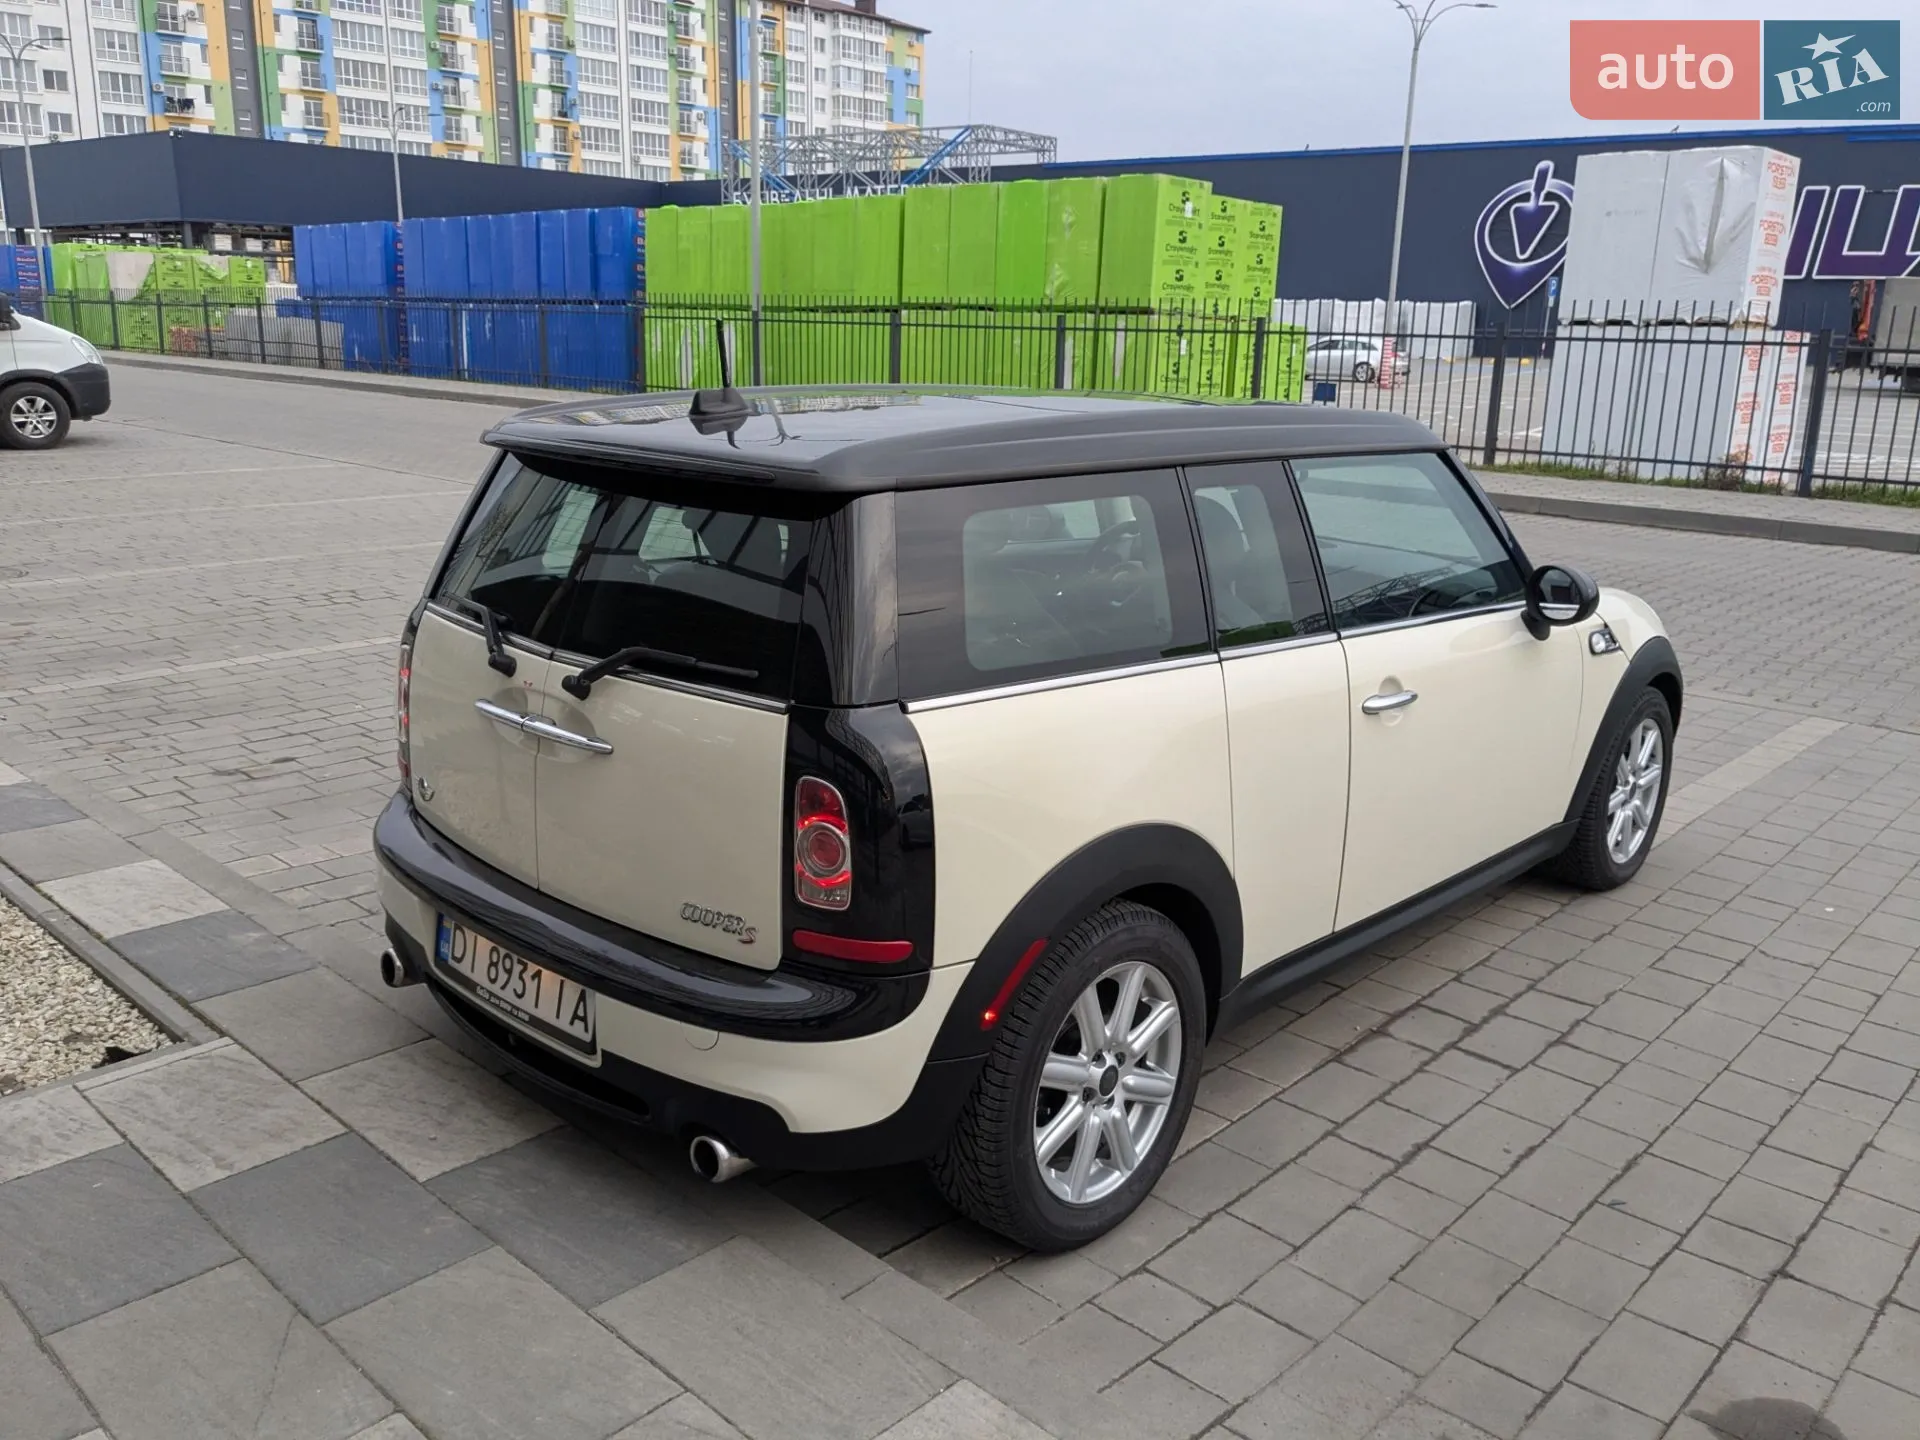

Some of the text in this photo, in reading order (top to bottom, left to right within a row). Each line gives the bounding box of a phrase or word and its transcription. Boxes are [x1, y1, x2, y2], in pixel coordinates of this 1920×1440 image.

[680, 902, 758, 945] COOPER S
[451, 922, 477, 974] DI
[486, 945, 543, 1009] 8931
[555, 978, 589, 1034] IA
